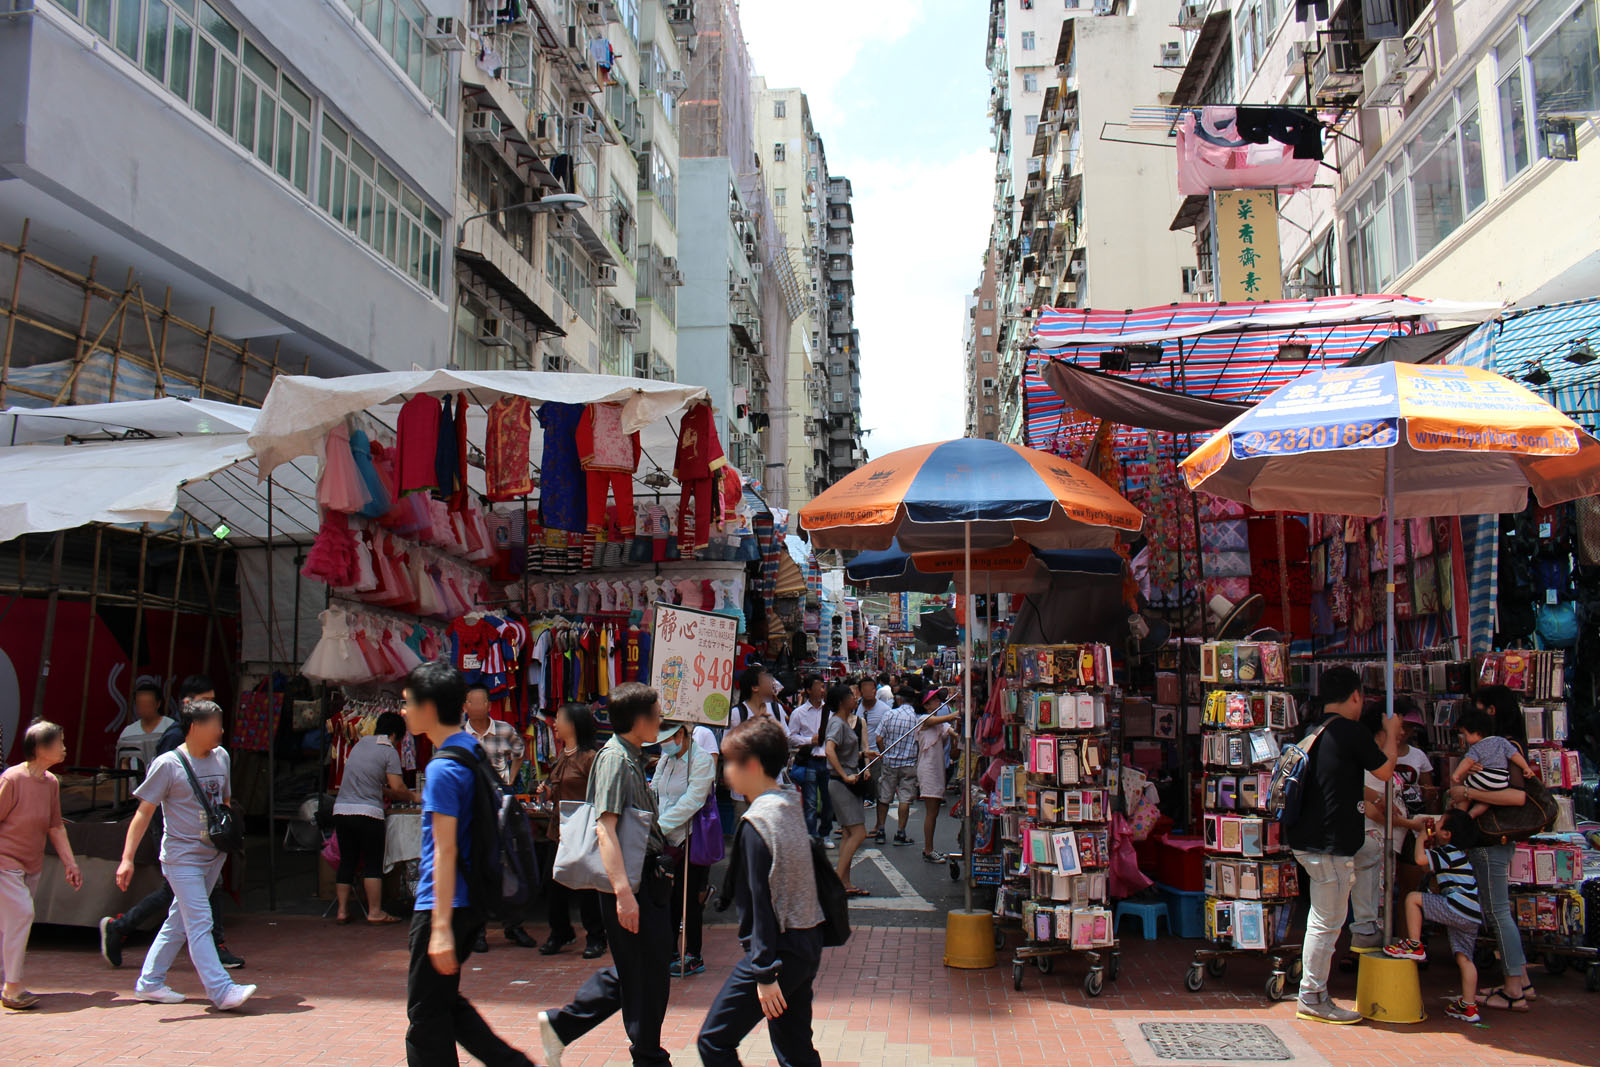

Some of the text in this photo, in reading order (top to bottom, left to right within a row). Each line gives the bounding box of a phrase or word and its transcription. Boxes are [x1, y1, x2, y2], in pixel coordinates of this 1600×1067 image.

[1237, 198, 1262, 302] 菜香齋素
[1414, 428, 1572, 449] www.flyerking.com.hk
[627, 644, 640, 663] 10
[495, 676, 501, 687] A
[692, 650, 733, 692] $48
